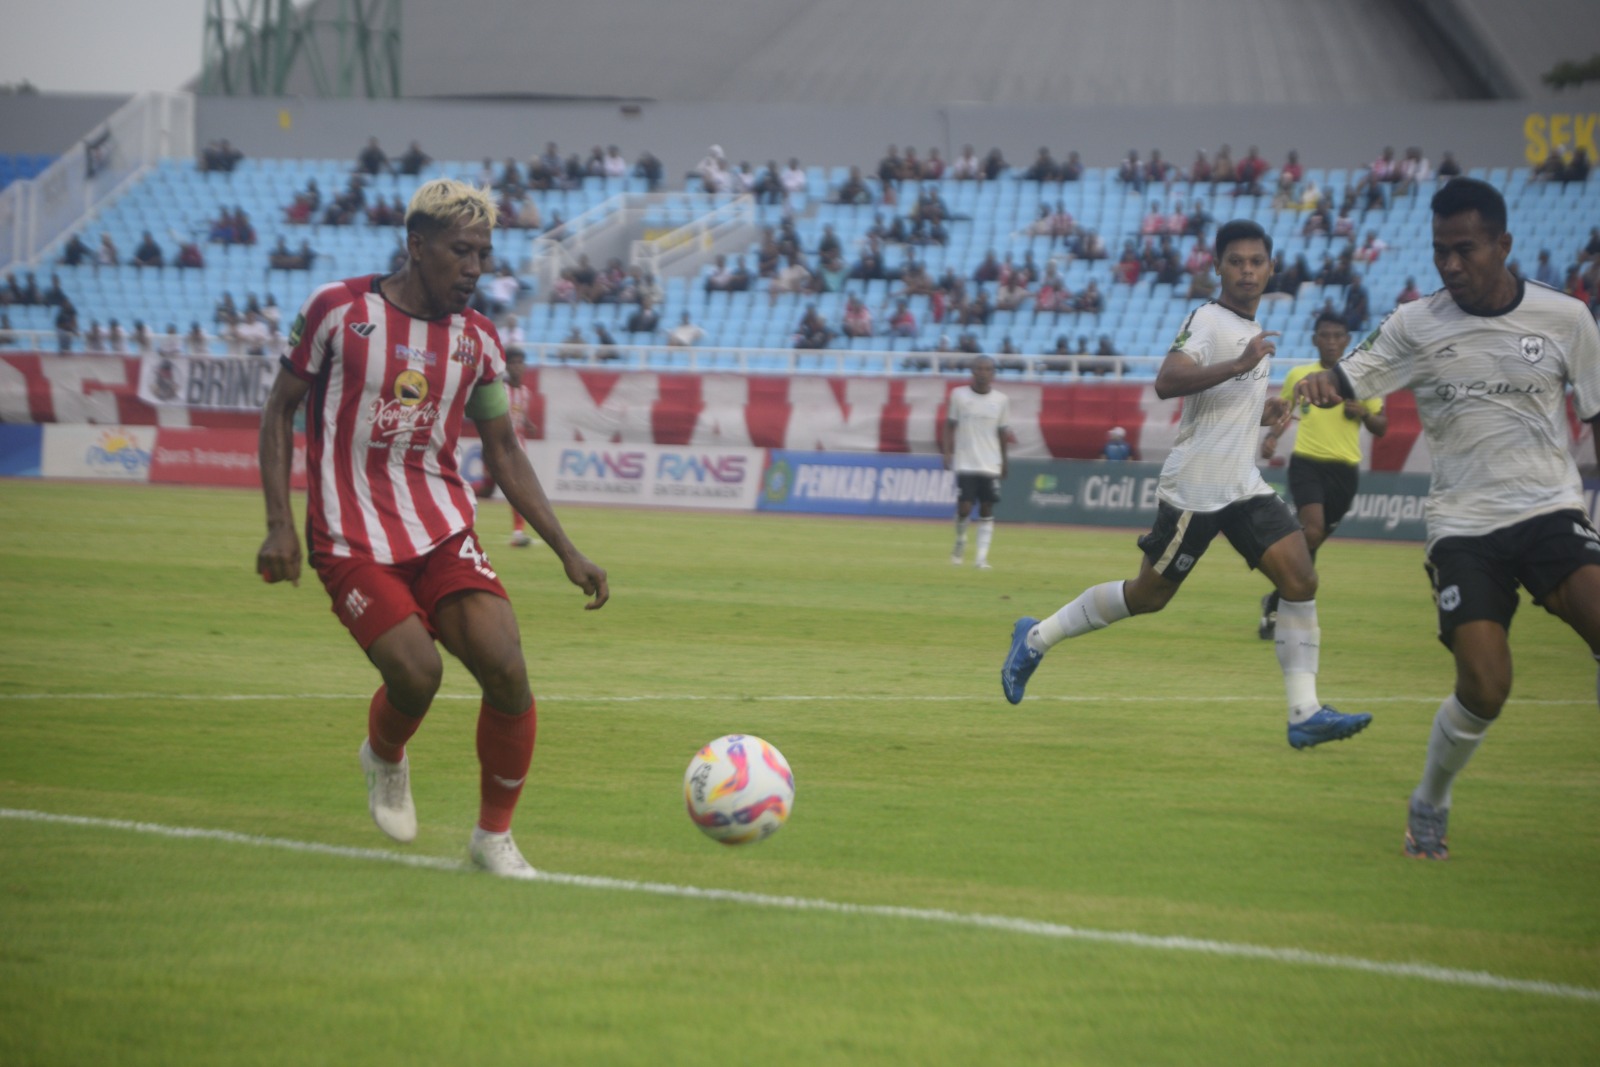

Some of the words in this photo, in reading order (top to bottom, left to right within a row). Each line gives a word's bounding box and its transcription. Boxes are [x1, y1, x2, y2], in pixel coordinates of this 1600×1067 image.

[1523, 112, 1600, 166] SEK
[559, 449, 646, 479] RANS
[656, 453, 747, 483] RANS
[794, 463, 878, 500] PEMKAB
[879, 466, 958, 503] SIDOAR
[1084, 475, 1136, 507] Cicil
